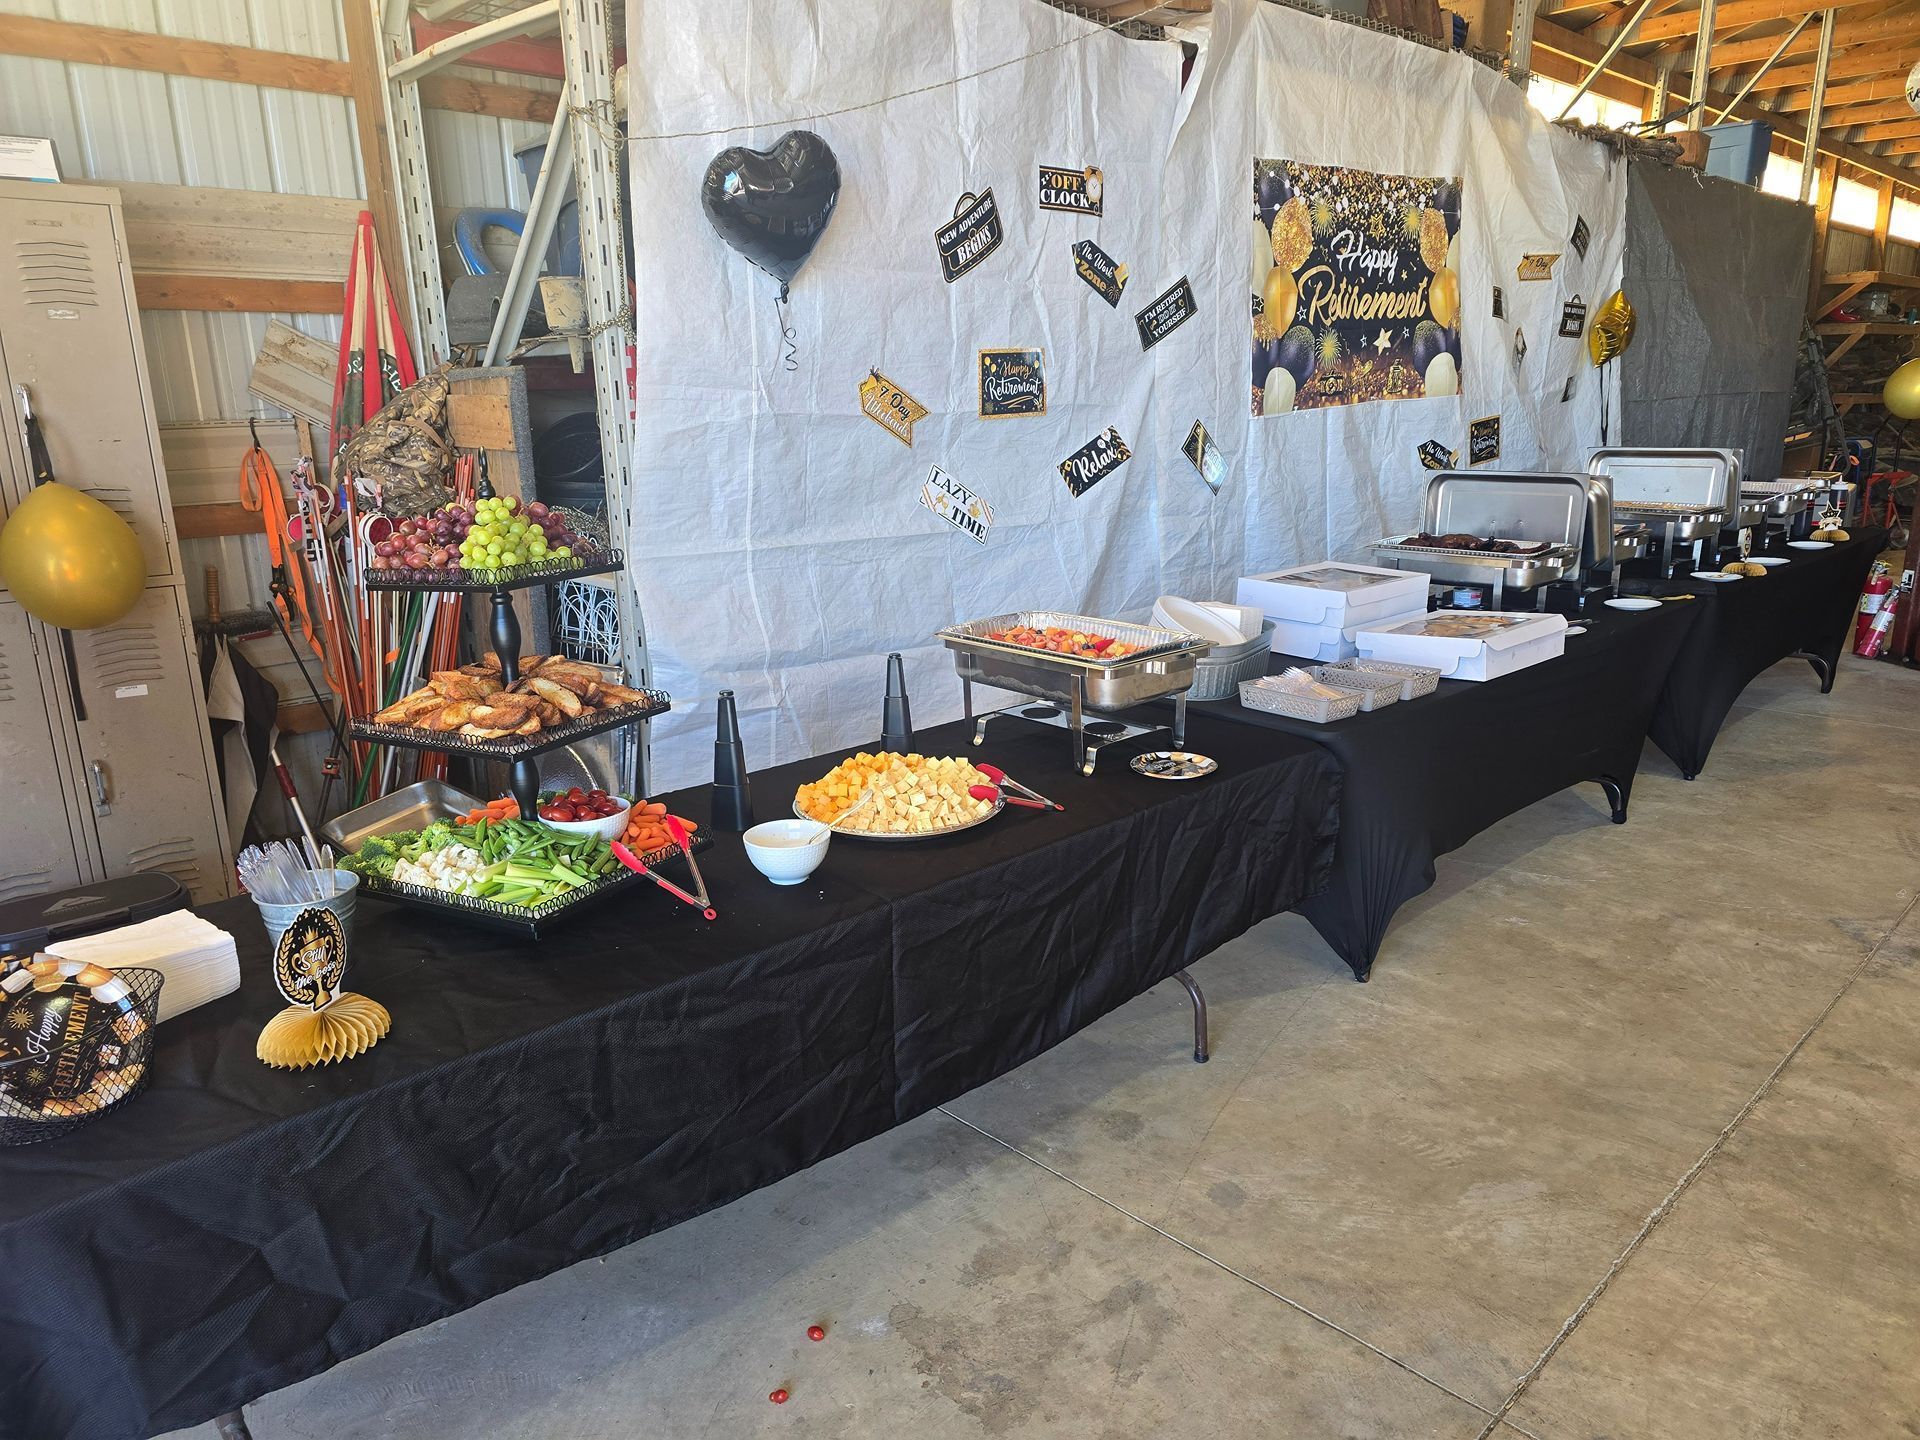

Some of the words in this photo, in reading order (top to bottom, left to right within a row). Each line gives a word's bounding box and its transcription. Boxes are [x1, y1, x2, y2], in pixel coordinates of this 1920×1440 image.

[1040, 189, 1090, 208] CLOCK
[1051, 174, 1081, 191] OFF
[940, 227, 957, 247] NEW
[958, 197, 994, 234] ADVENTURE
[956, 226, 992, 264] BEGINS
[1081, 242, 1093, 260] No
[1094, 253, 1114, 279] Work
[1330, 228, 1399, 284] Happy
[1079, 259, 1107, 292] Zone
[1144, 310, 1157, 323] I'M
[1155, 287, 1184, 314] RETIRED
[1298, 265, 1428, 326] Retirement
[1152, 307, 1187, 337] YOURSELF
[1000, 360, 1032, 379] Happy
[879, 386, 889, 398] 7
[890, 392, 911, 421] Day
[985, 377, 1041, 401] Retirement
[865, 391, 909, 438] Weekends
[1072, 446, 1118, 484] Relax
[1425, 441, 1434, 454] No
[1434, 445, 1449, 463] Work
[930, 470, 972, 506] LAZY
[951, 505, 987, 541] TIME
[295, 975, 313, 990] the
[315, 960, 337, 981] boss
[301, 946, 326, 971] Still
[25, 1006, 62, 1064] Happy
[53, 991, 91, 1088] RETIREMENT
